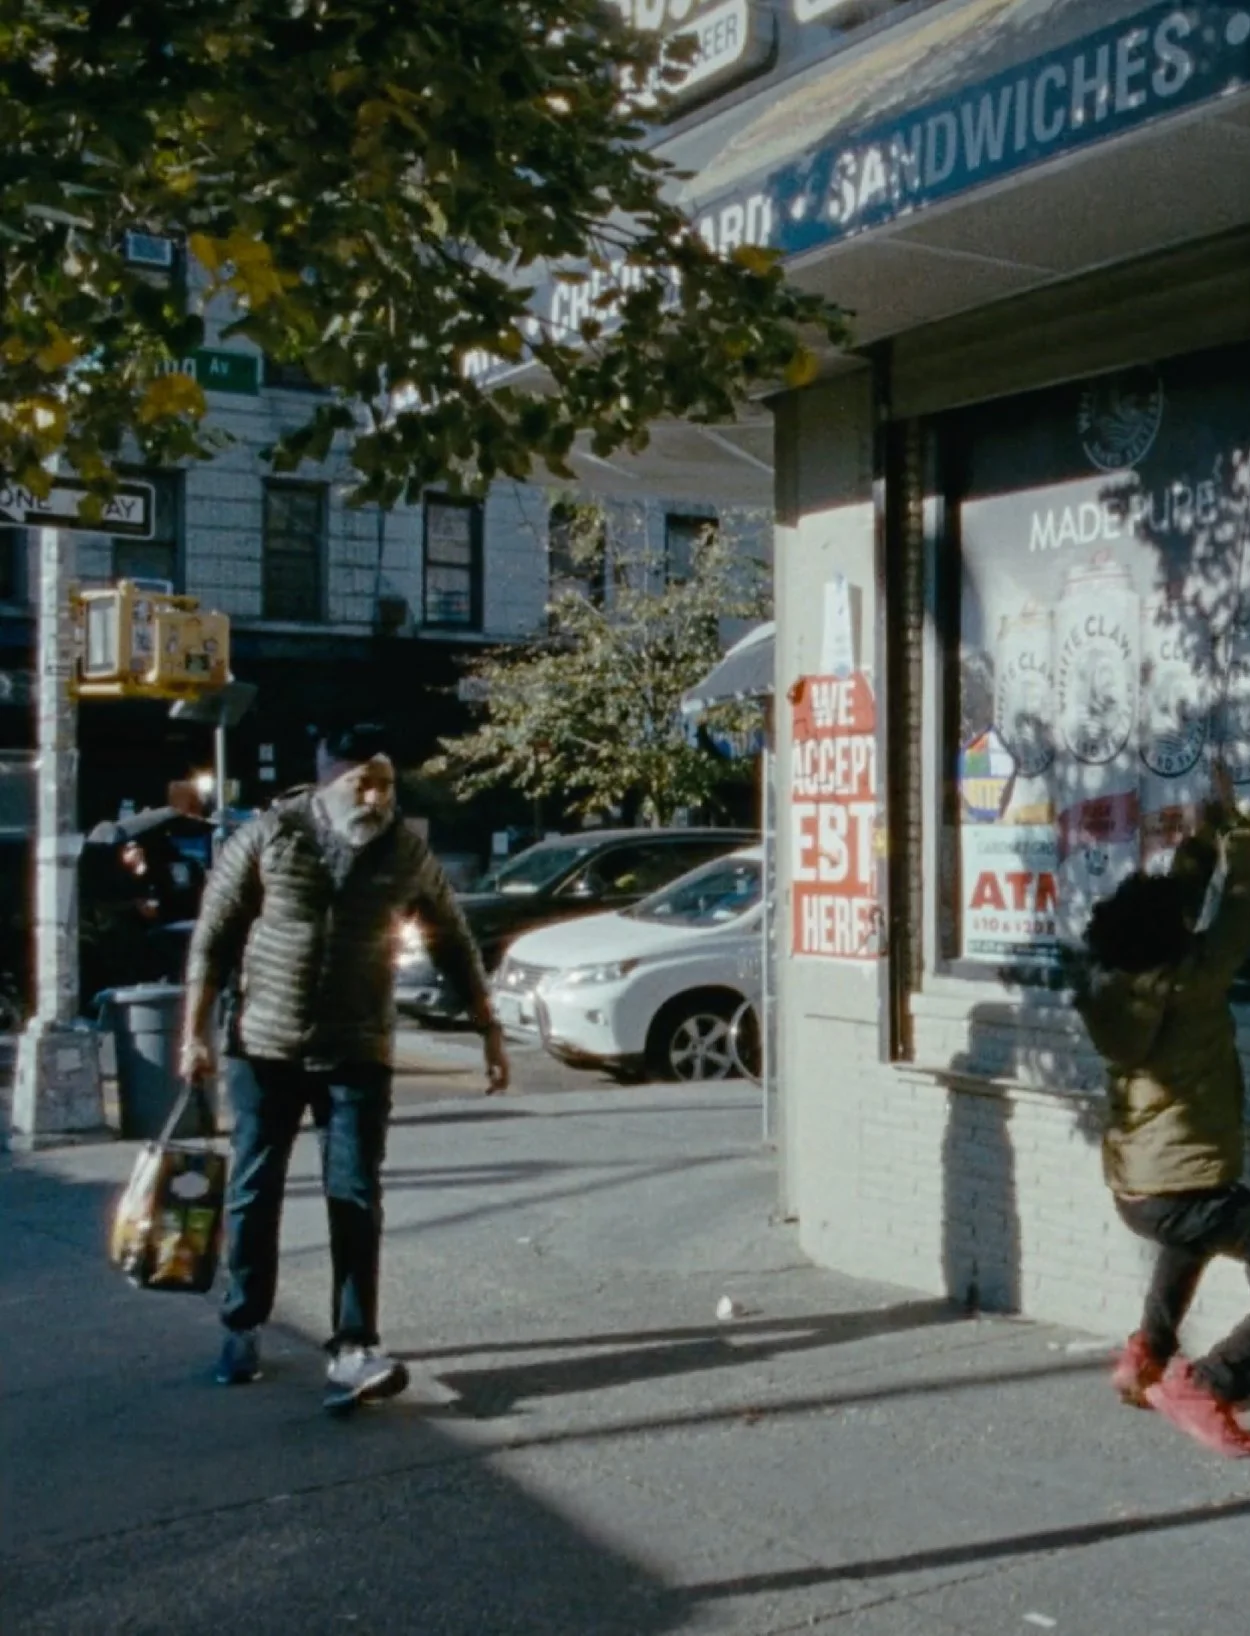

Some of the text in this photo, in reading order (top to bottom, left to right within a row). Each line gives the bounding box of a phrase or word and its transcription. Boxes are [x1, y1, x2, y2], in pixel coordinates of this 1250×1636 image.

[694, 14, 738, 64] EER
[672, 195, 772, 268] ARD
[829, 12, 1192, 222] SANDWICHES
[104, 497, 136, 518] AY
[1030, 501, 1124, 552] MADE
[811, 681, 856, 728] WE
[791, 737, 877, 797] ACCEPT
[791, 802, 877, 883] EBT
[802, 895, 877, 955] HERE
